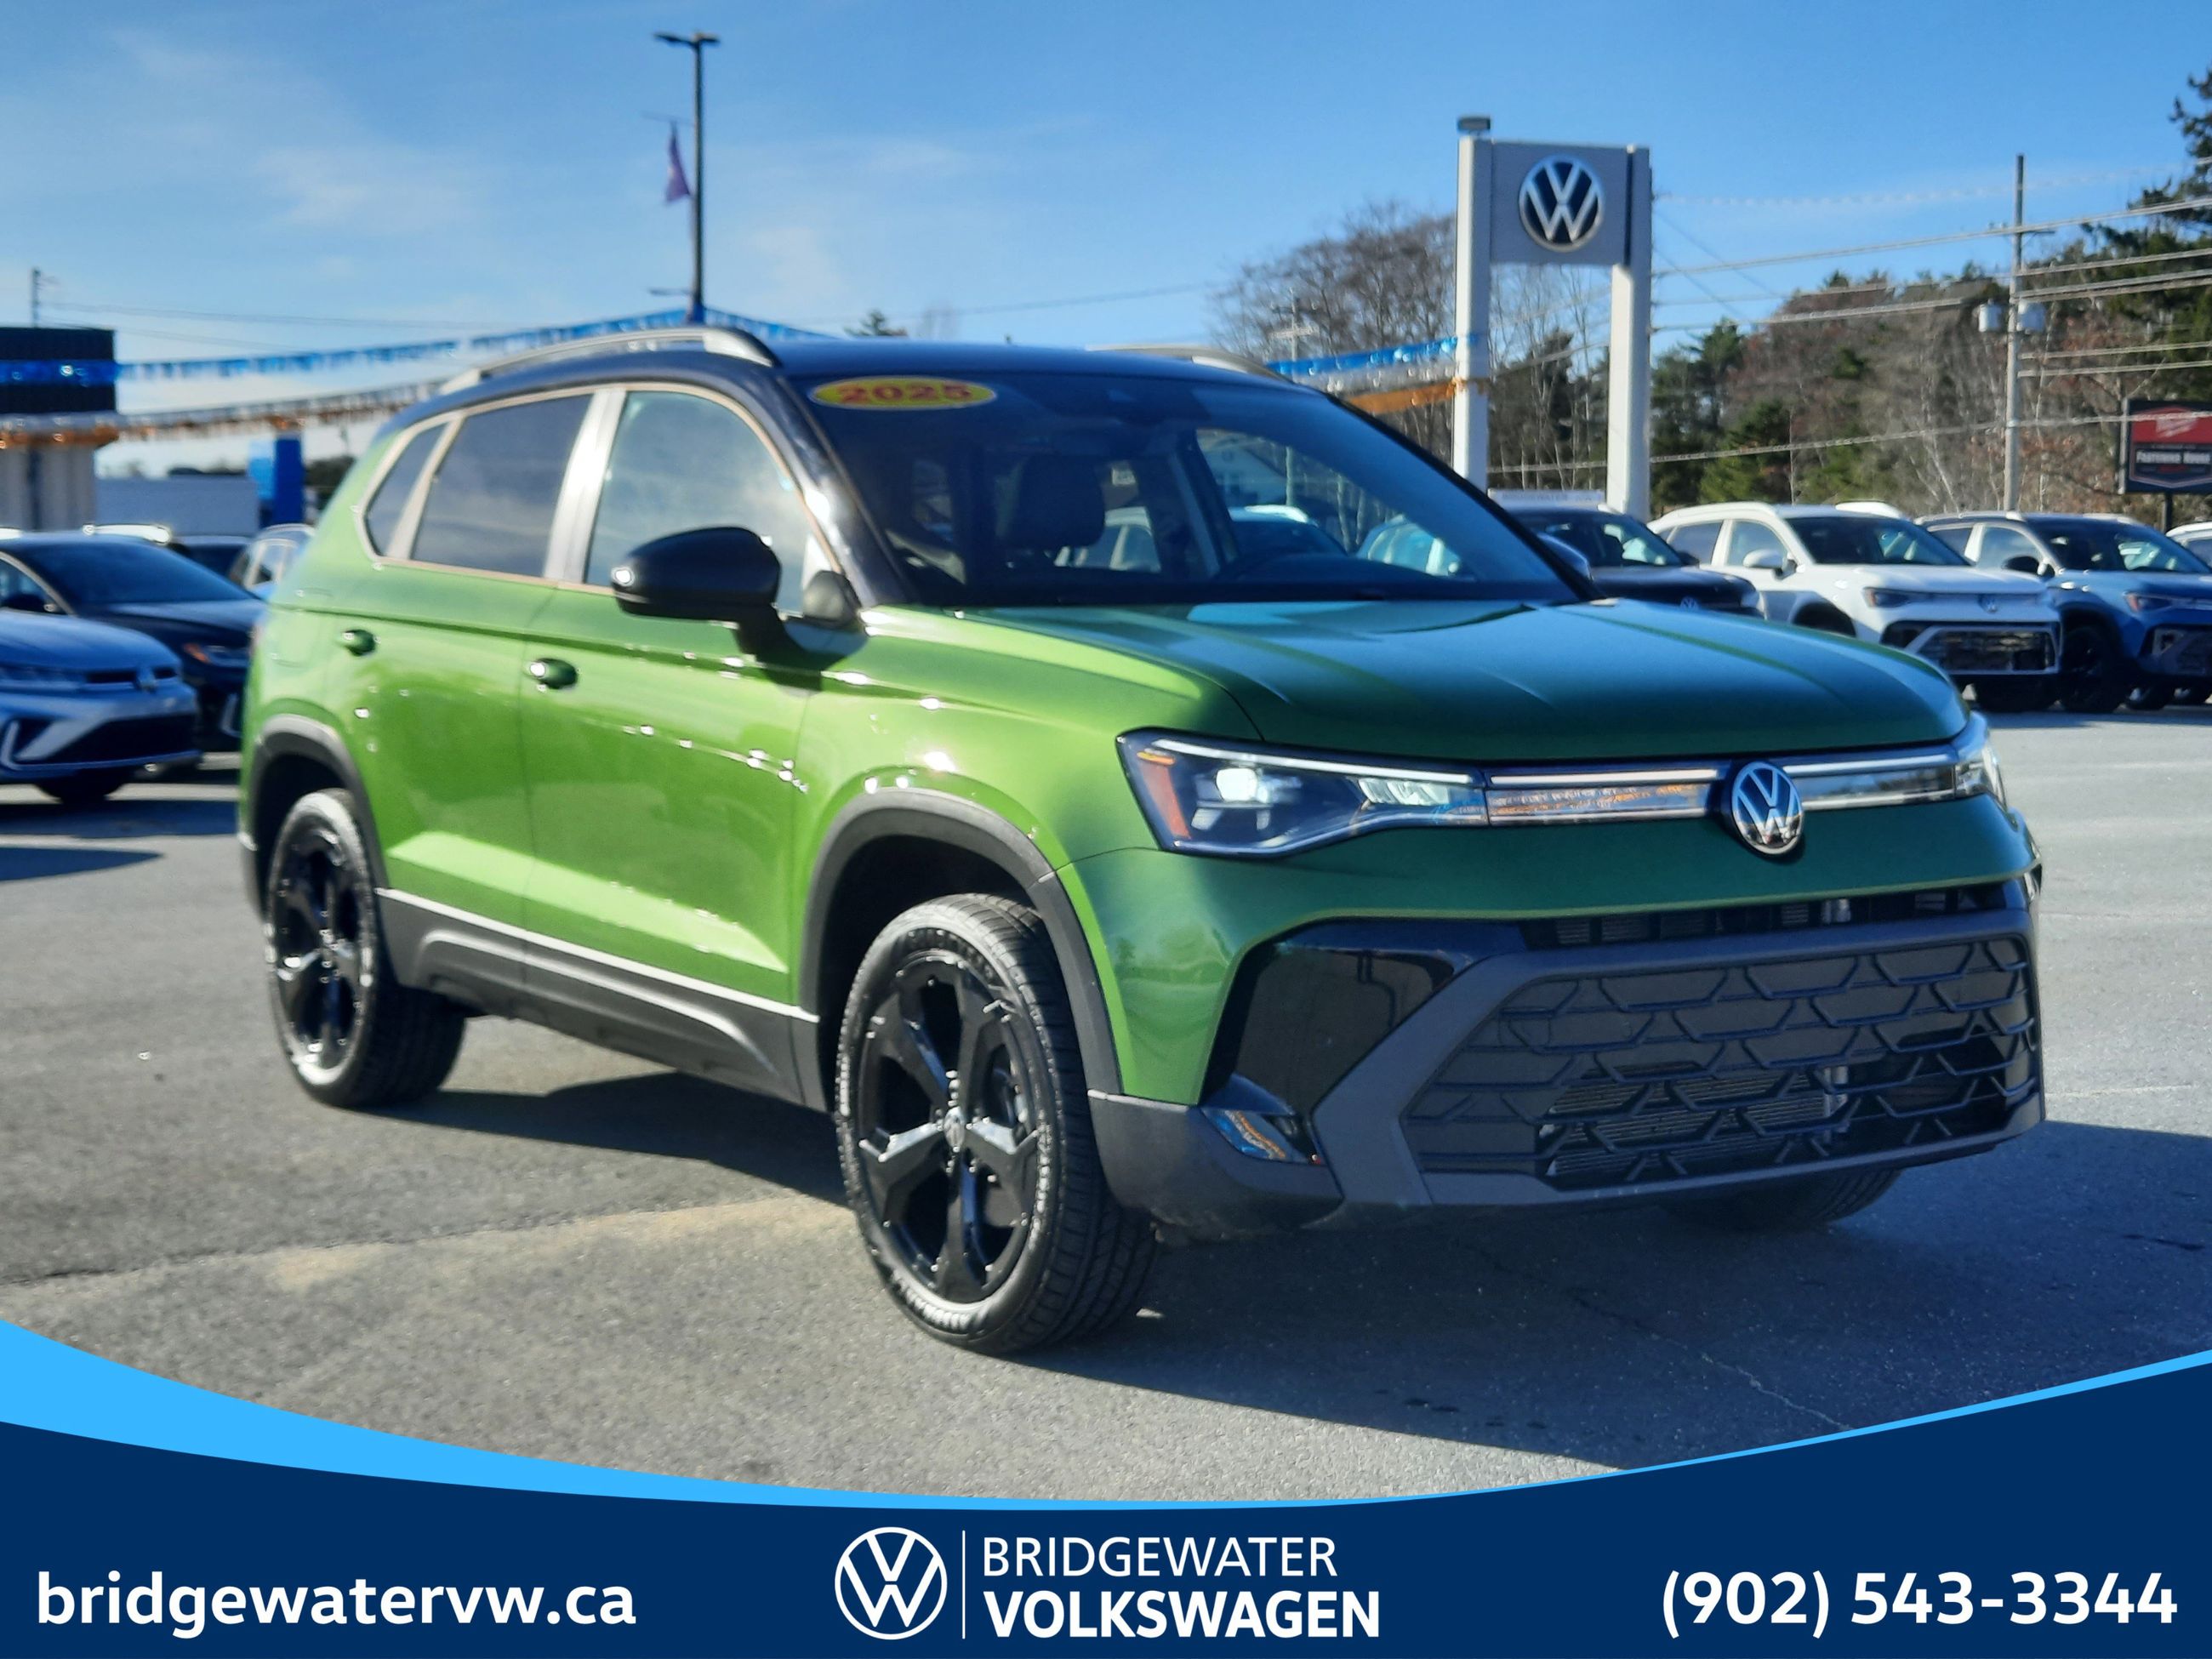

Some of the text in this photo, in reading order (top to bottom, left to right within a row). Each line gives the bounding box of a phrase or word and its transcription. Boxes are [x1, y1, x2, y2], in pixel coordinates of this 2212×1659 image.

[1519, 155, 1605, 252] VW
[837, 383, 972, 404] 2025
[1732, 761, 1803, 854] VW
